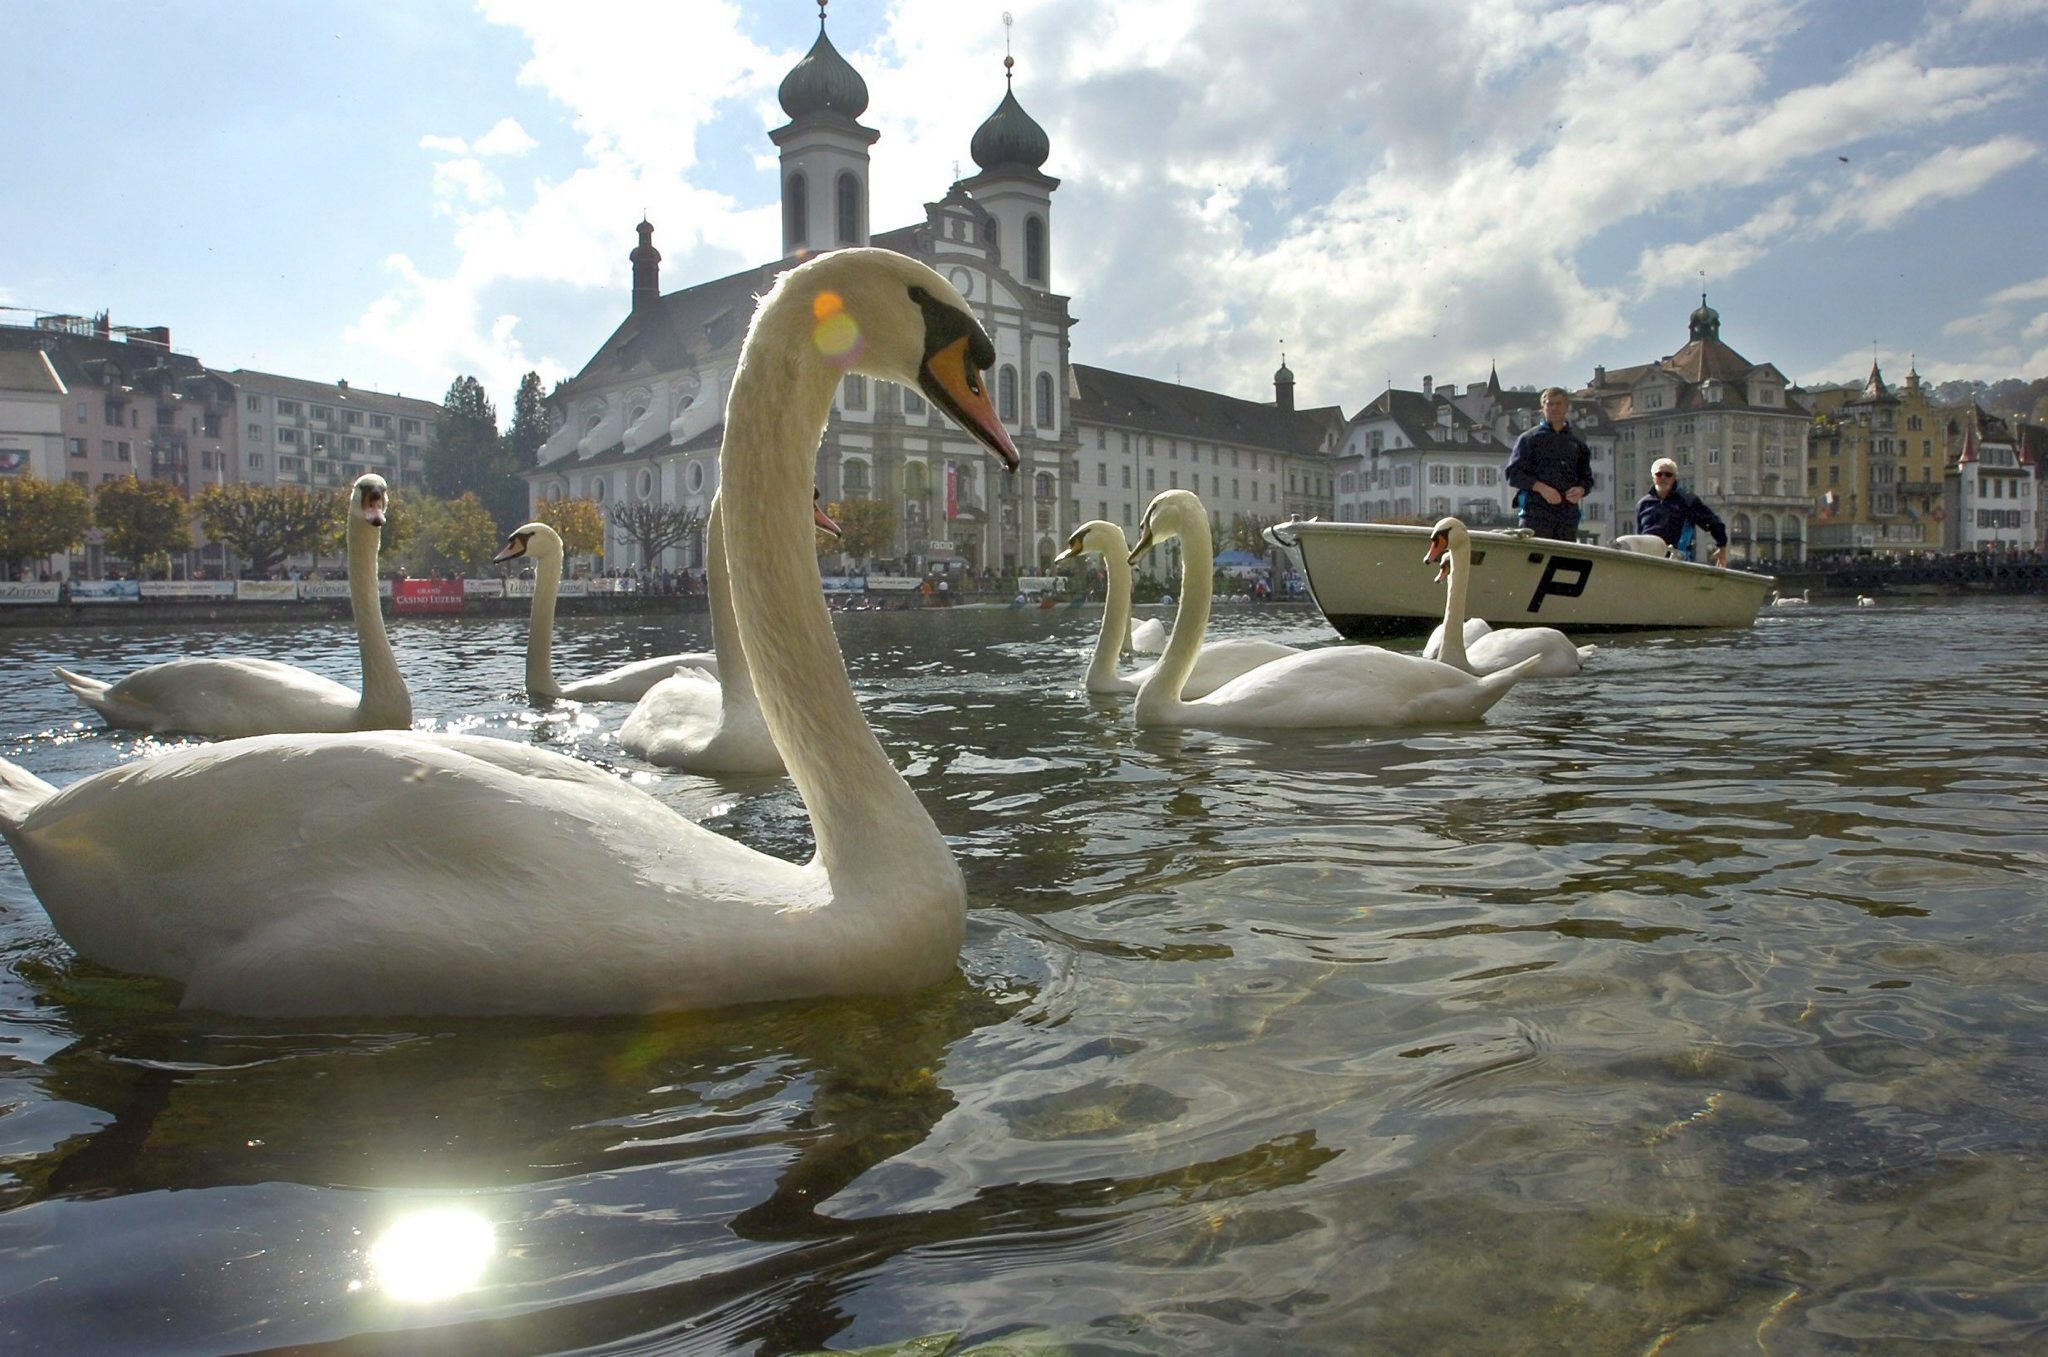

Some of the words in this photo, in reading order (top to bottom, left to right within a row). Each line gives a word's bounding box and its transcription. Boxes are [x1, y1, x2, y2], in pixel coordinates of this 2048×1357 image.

[396, 595, 428, 605] CASINO
[430, 595, 462, 604] LUZERN
[1527, 555, 1593, 613] P
